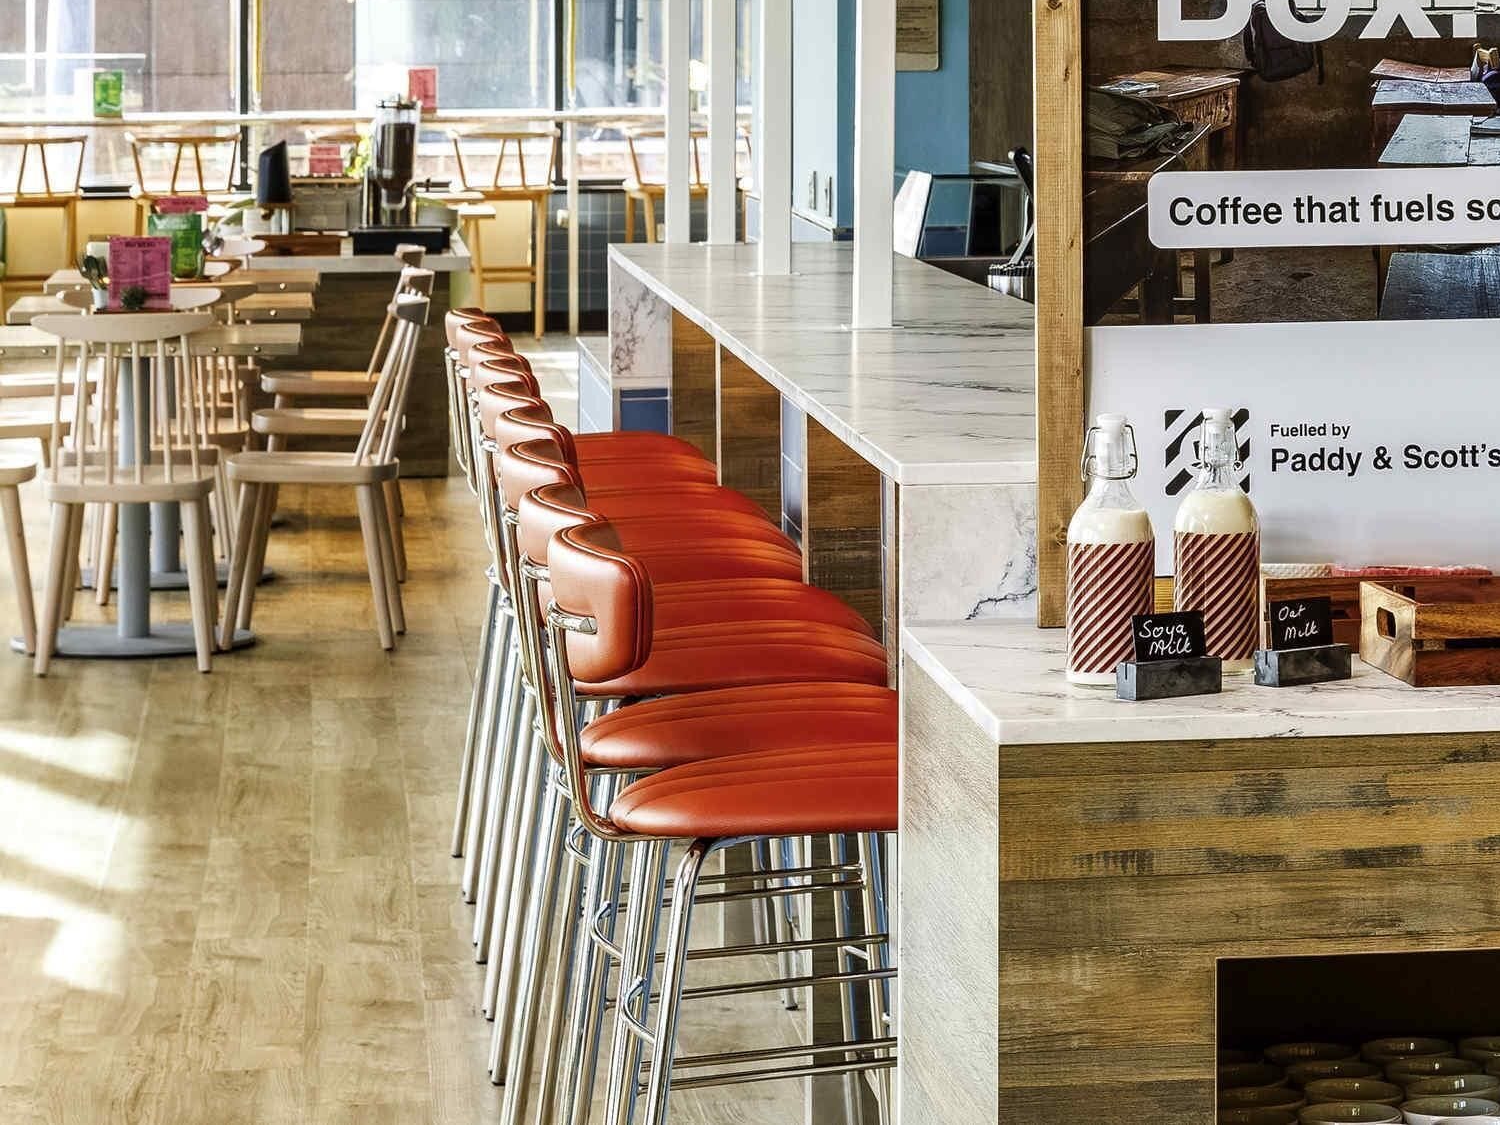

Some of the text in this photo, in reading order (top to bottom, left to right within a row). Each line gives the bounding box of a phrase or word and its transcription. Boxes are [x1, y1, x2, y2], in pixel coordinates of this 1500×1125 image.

[1169, 196, 1282, 226] Coffee
[1293, 195, 1360, 223] that
[1370, 194, 1454, 222] fuels
[1271, 423, 1350, 439] Fuelled by
[1272, 447, 1362, 477] Paddy
[1373, 446, 1393, 470] &
[1278, 604, 1307, 621] Oat
[1139, 620, 1188, 641] Soya
[1284, 622, 1319, 641] Milk
[1148, 638, 1192, 655] Milk
